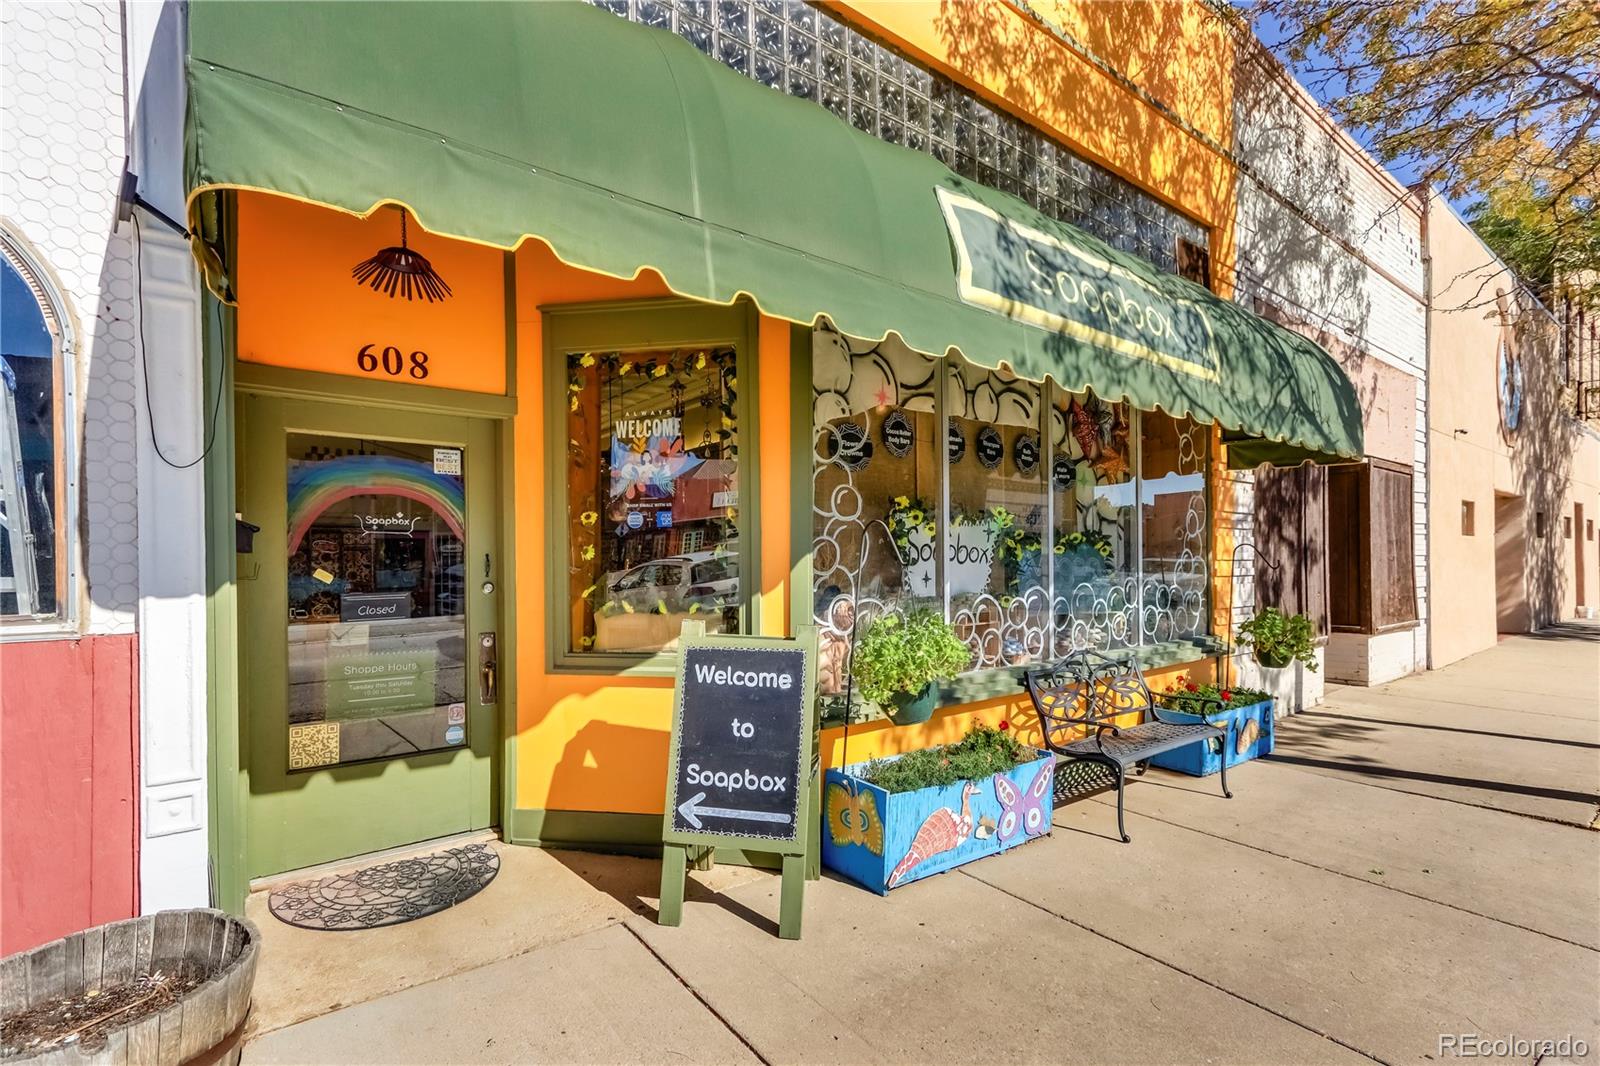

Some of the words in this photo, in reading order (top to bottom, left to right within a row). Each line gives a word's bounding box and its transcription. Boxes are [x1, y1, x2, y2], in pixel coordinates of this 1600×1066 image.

[1025, 249, 1180, 344] Soapbox
[357, 343, 429, 380] 608
[625, 409, 672, 417] ALWAYS
[615, 417, 682, 438] WELCOME
[365, 515, 410, 527] Soapbox
[357, 603, 397, 616] Closed
[344, 664, 385, 676] Shoppe
[387, 662, 417, 672] Hours
[695, 663, 793, 690] Welcome
[731, 718, 755, 738] to
[686, 763, 787, 793] Soapbox
